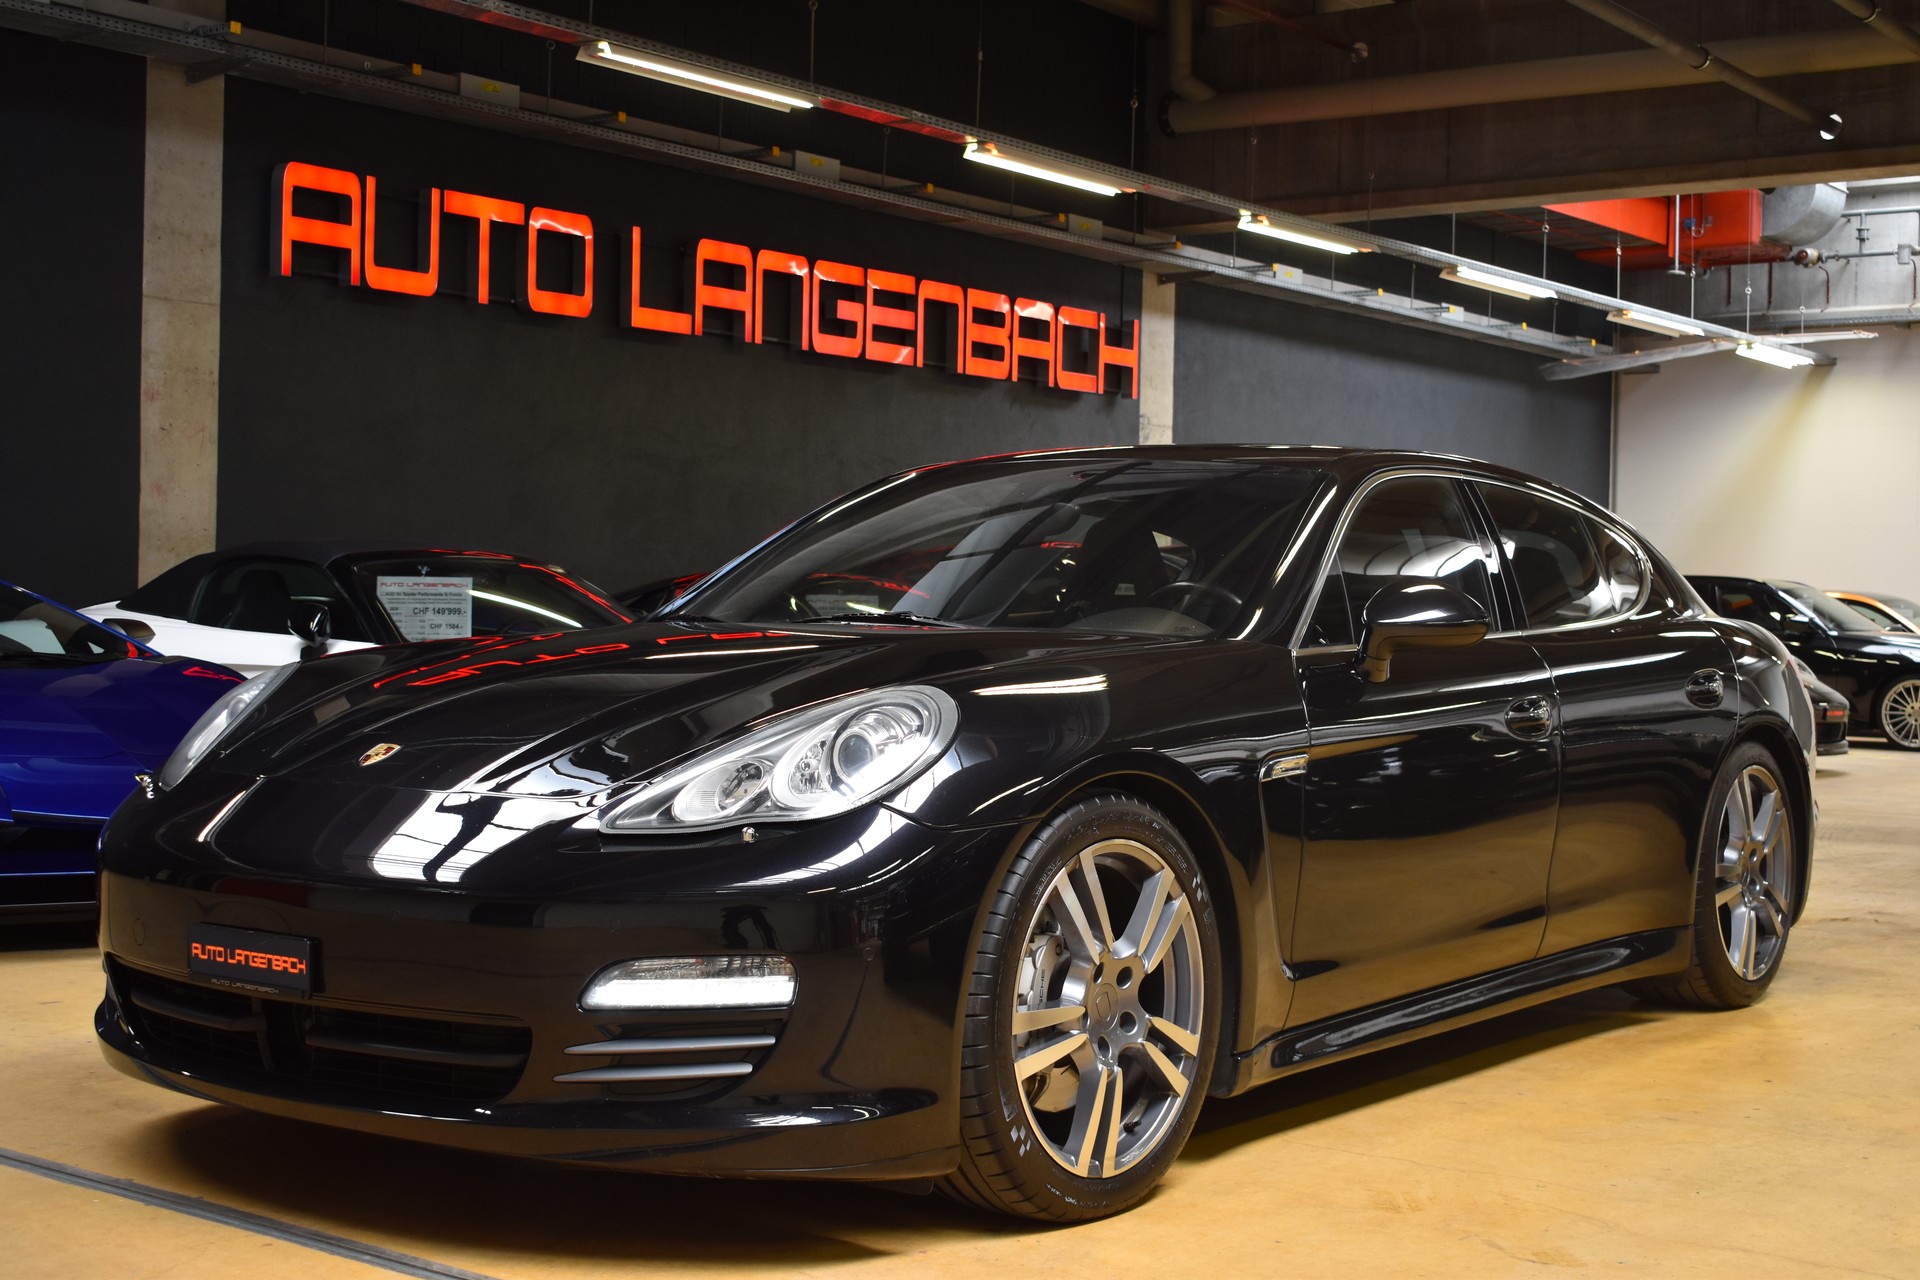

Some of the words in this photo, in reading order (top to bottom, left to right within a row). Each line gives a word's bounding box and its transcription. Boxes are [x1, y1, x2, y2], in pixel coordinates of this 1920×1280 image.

[281, 161, 594, 318] AUTO
[631, 225, 1140, 400] LANGENBACH
[412, 607, 430, 616] CHF
[191, 942, 225, 962] AUTO
[227, 948, 306, 975] LANGENBACH
[211, 978, 230, 986] AUTO
[231, 981, 279, 993] LANGENBACH
